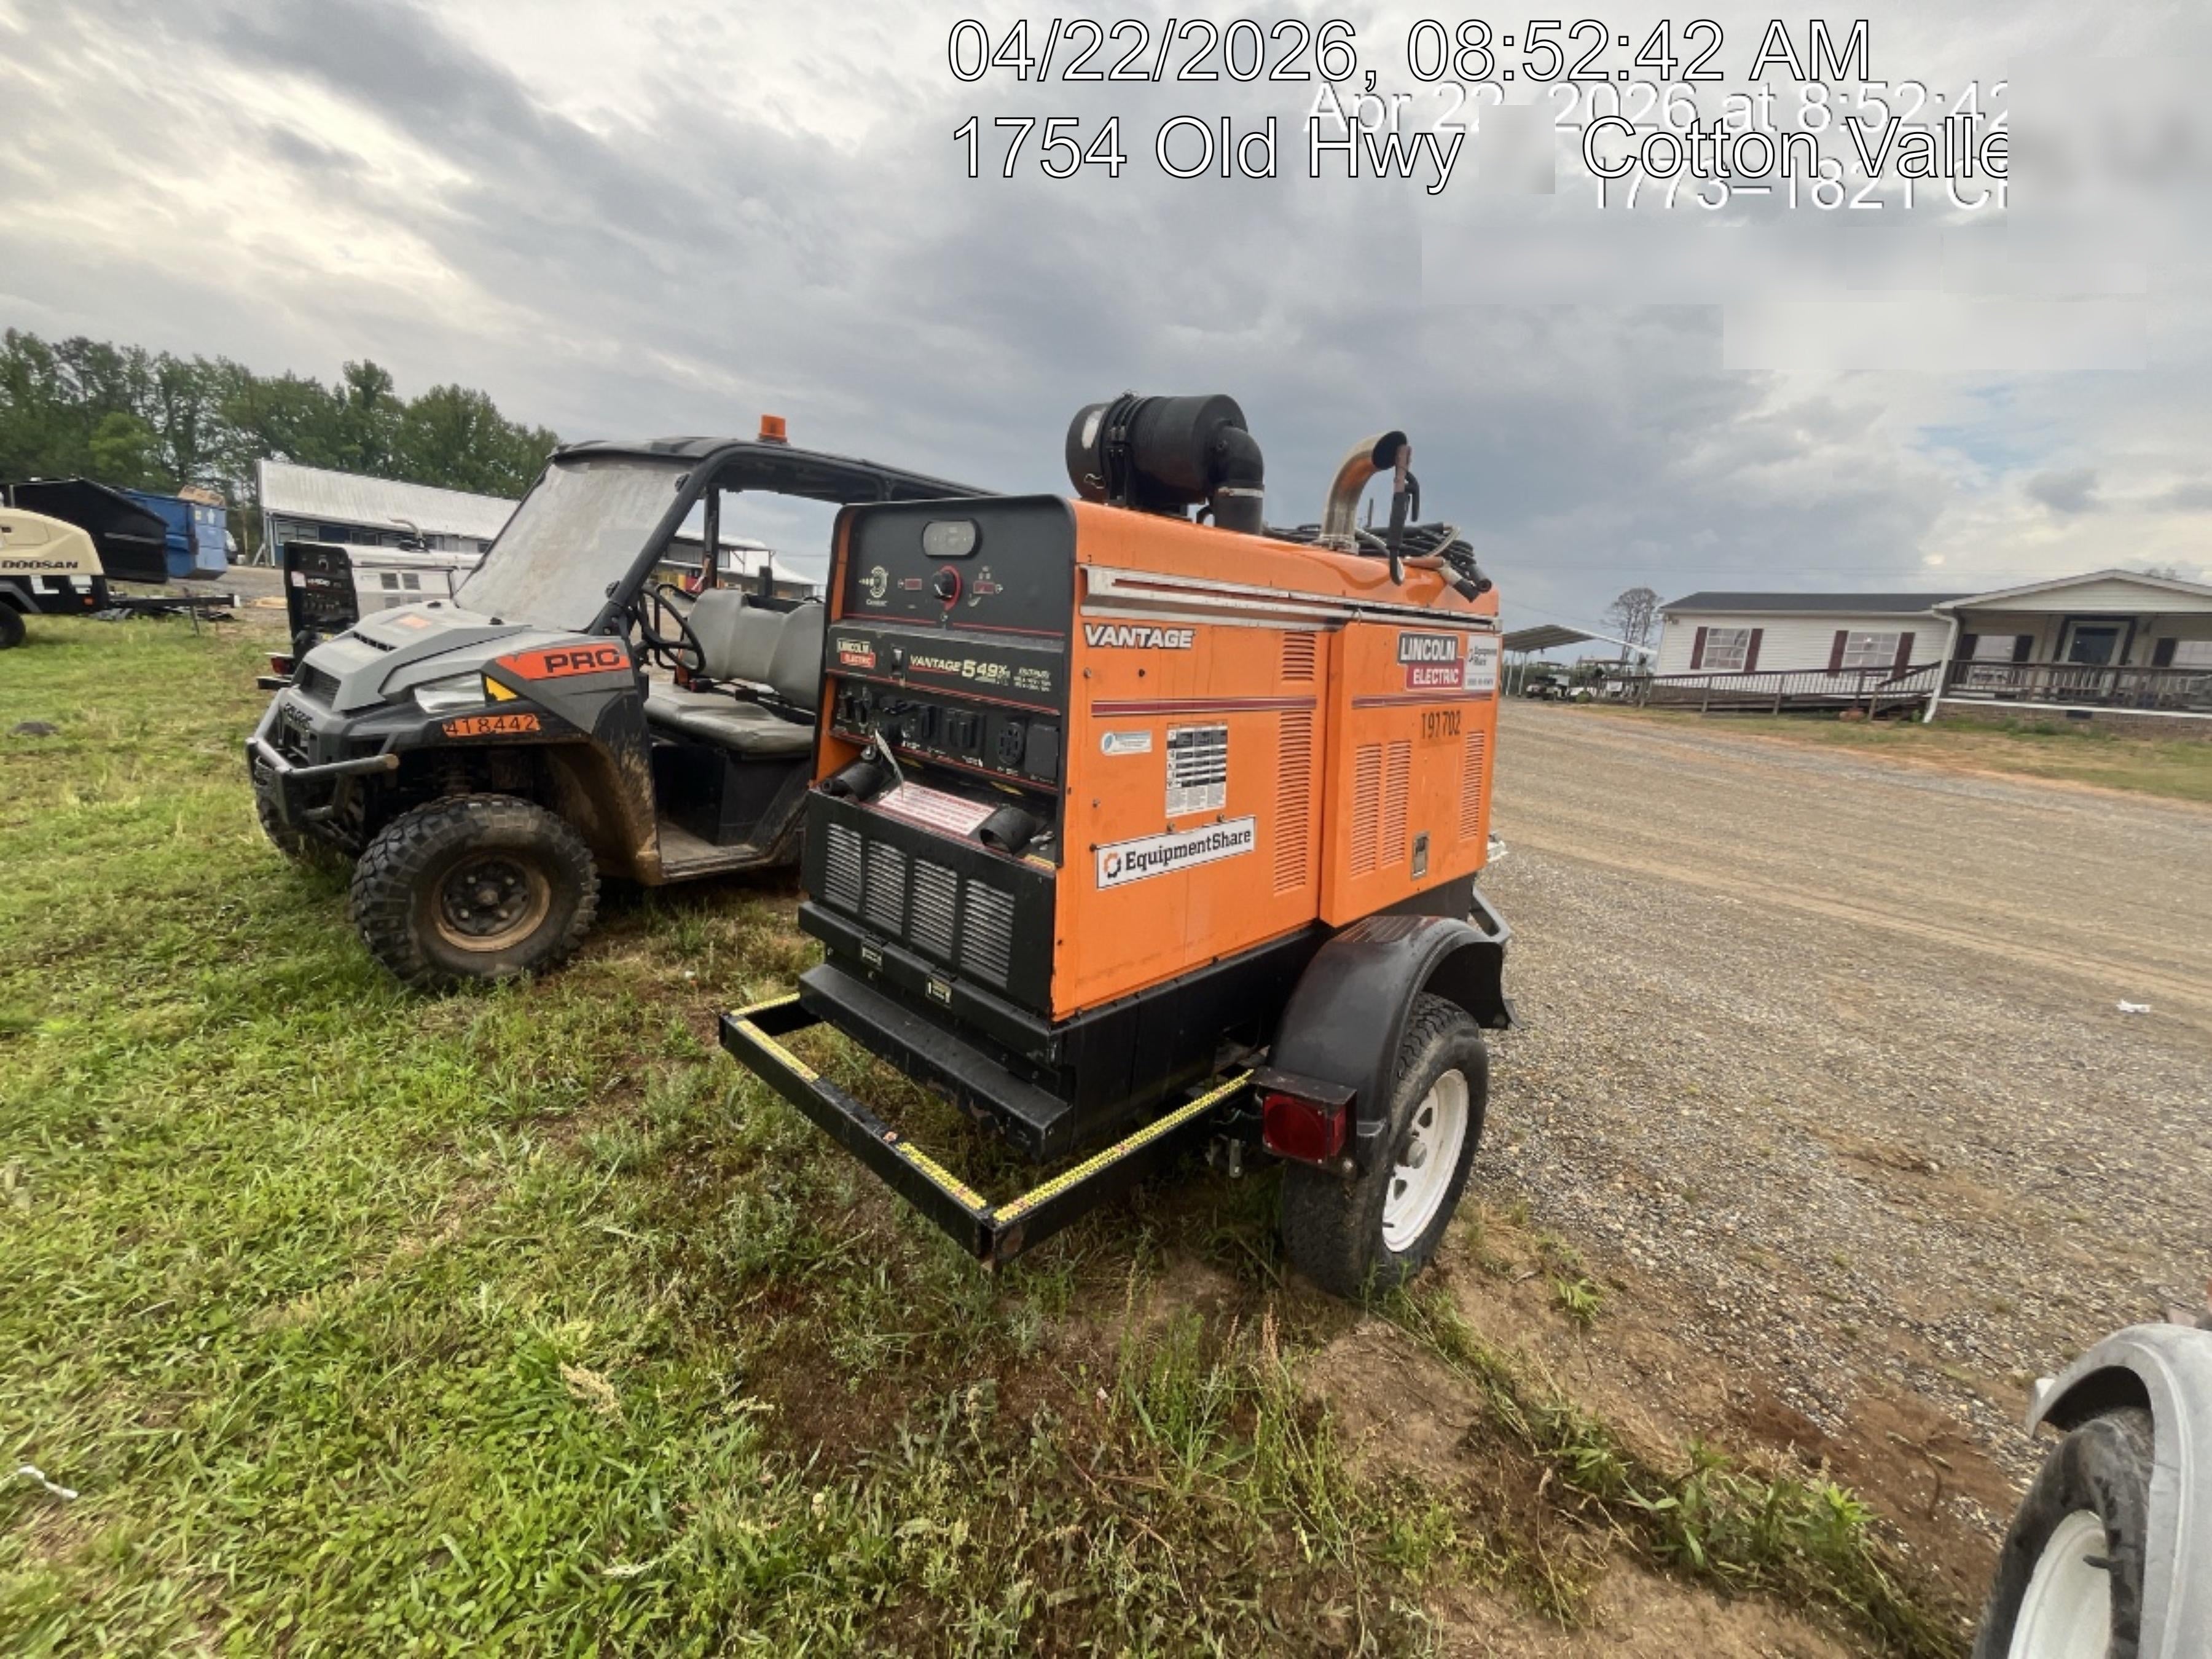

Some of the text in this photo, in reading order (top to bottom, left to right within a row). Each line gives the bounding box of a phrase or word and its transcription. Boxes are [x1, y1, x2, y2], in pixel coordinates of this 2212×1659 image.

[2, 560, 79, 569] DOOSAN
[1084, 624, 1196, 649] VANTAGE
[1400, 637, 1456, 661] LINCOLN
[544, 648, 621, 673] PRO
[910, 654, 962, 672] VANTAGE
[1413, 668, 1459, 685] ELECTRIC
[445, 714, 535, 735] 418442
[1125, 830, 1251, 871] EquipmentShare
